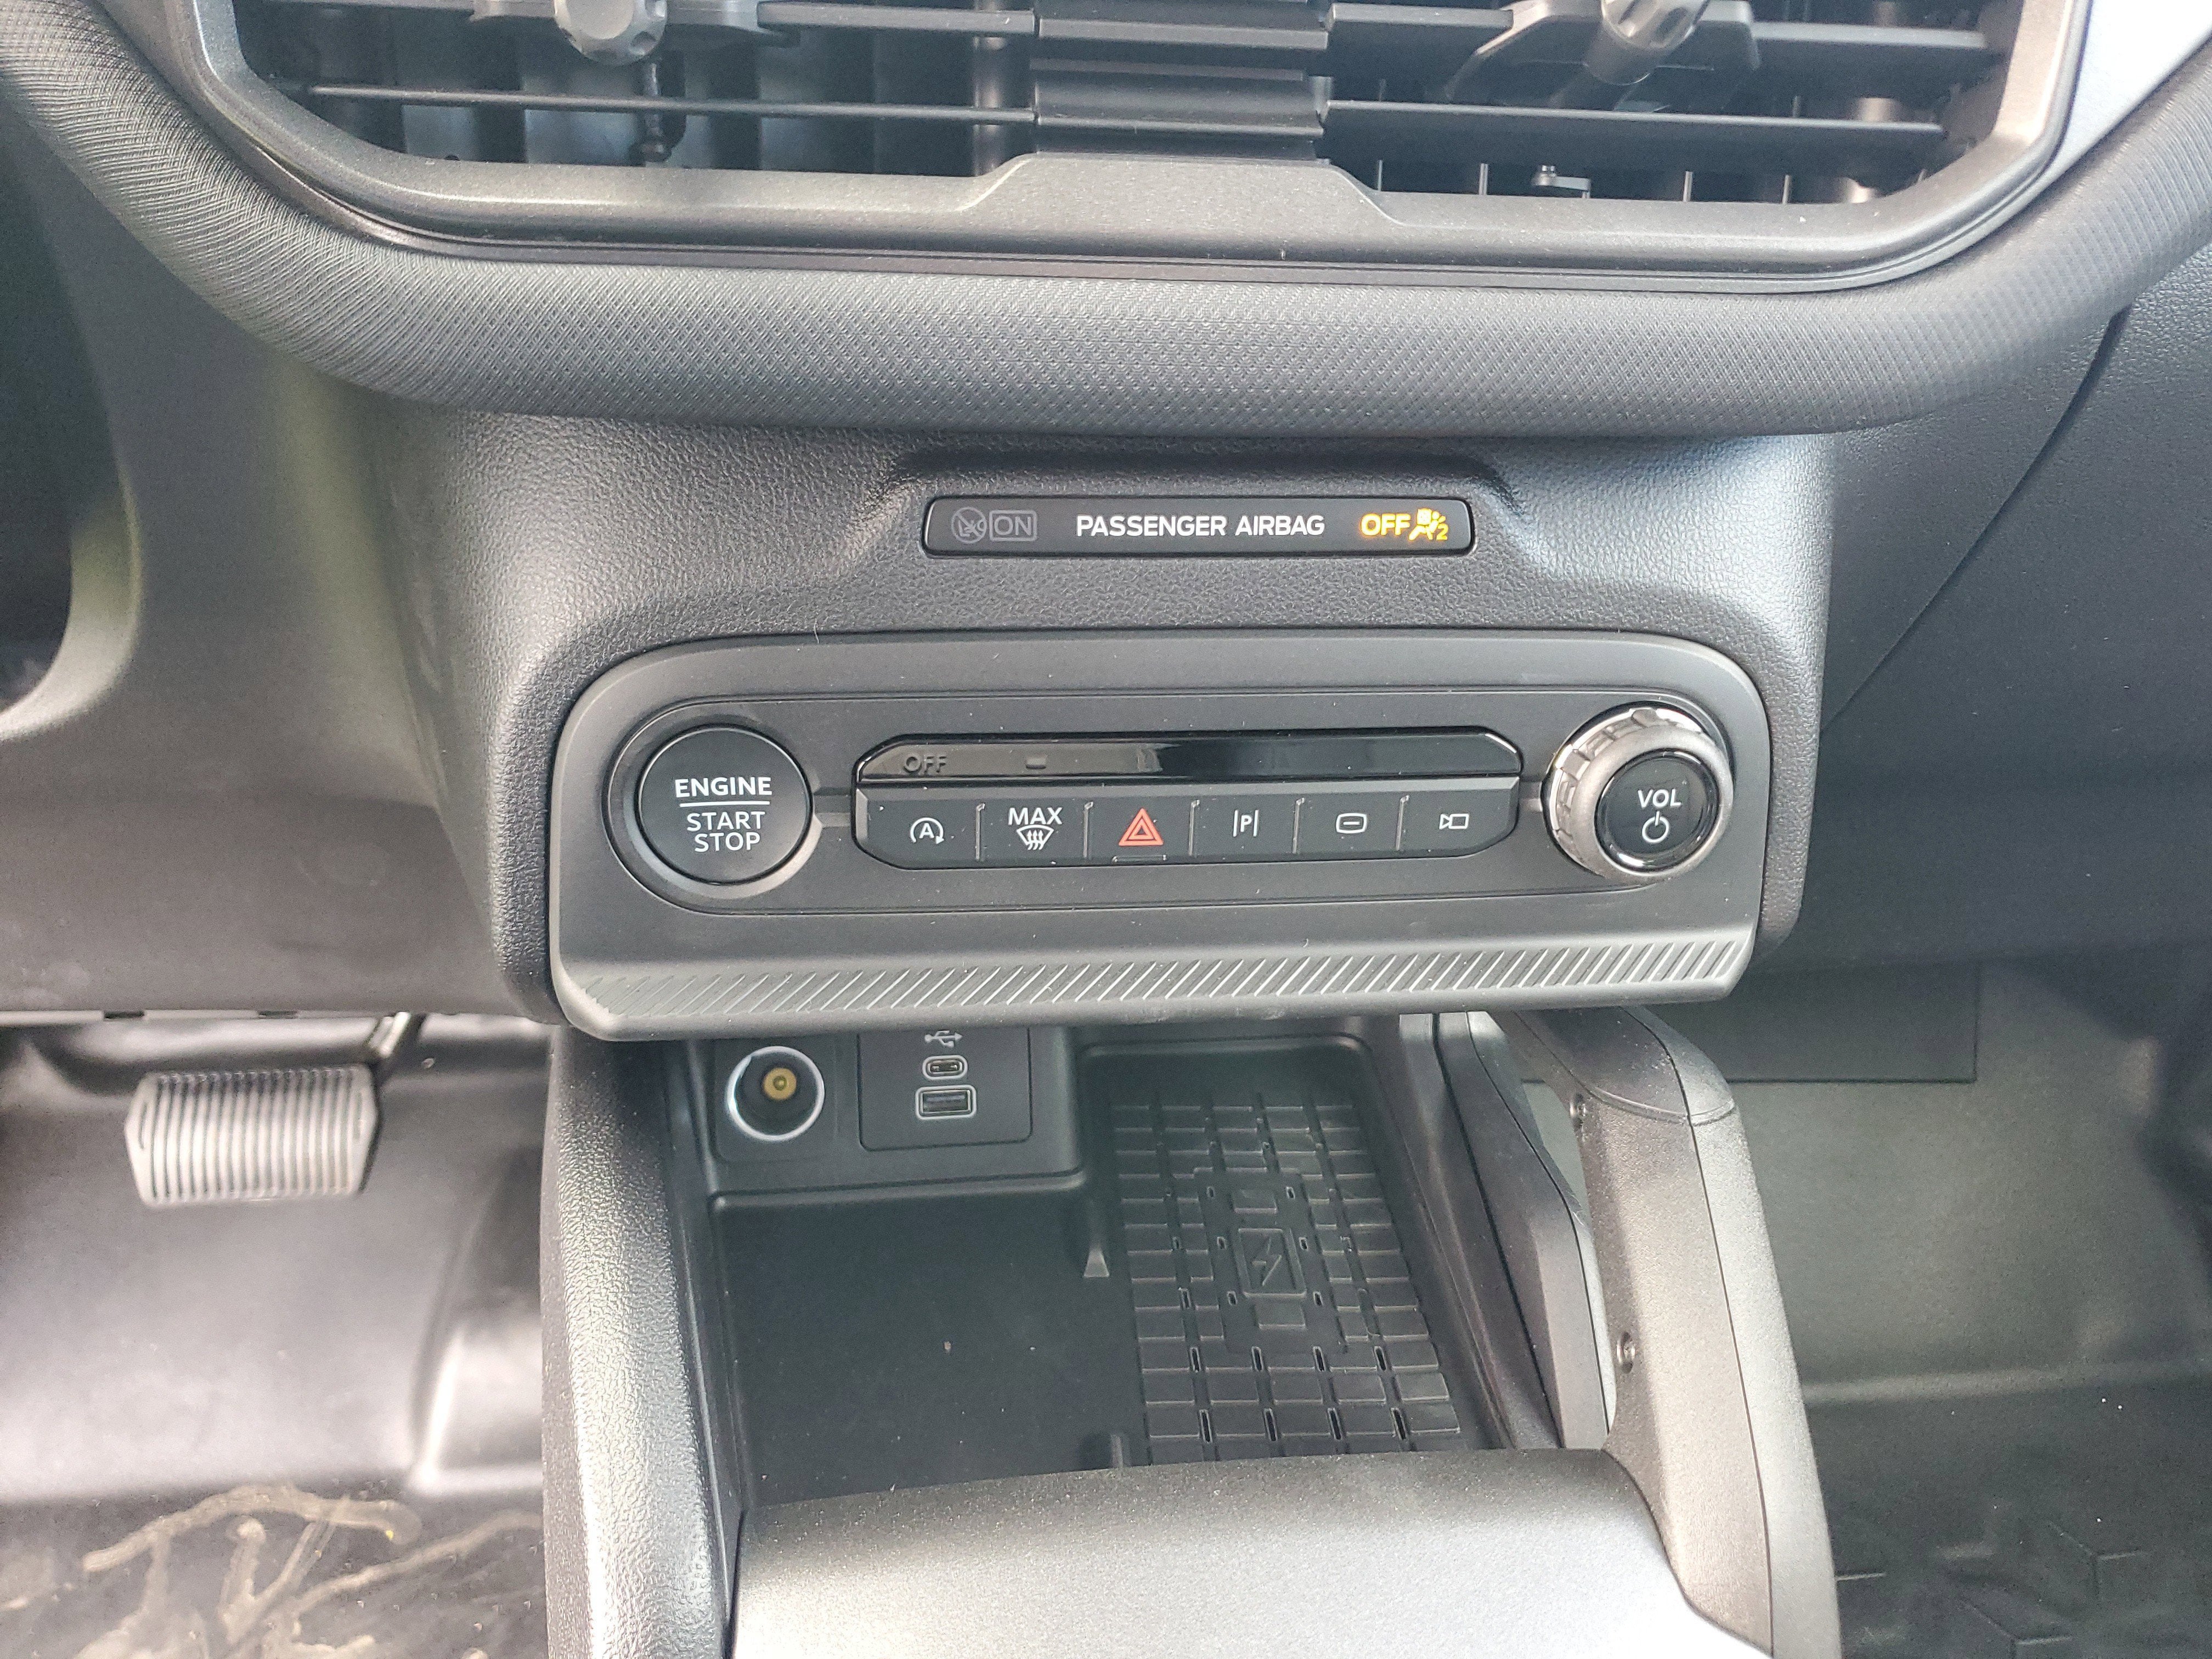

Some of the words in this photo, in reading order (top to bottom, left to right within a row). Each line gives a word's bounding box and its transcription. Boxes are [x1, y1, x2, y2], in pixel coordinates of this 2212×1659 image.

[994, 516, 1031, 536] ON
[1076, 515, 1226, 537] PASSENGER
[1235, 515, 1325, 536] AIRBAG
[1361, 512, 1412, 536] OFF
[903, 753, 947, 773] OFF
[674, 777, 773, 798] ENGINE
[1637, 788, 1681, 808] VOL
[686, 811, 766, 832] START
[1008, 807, 1063, 825] MAX
[694, 832, 760, 853] STOP
